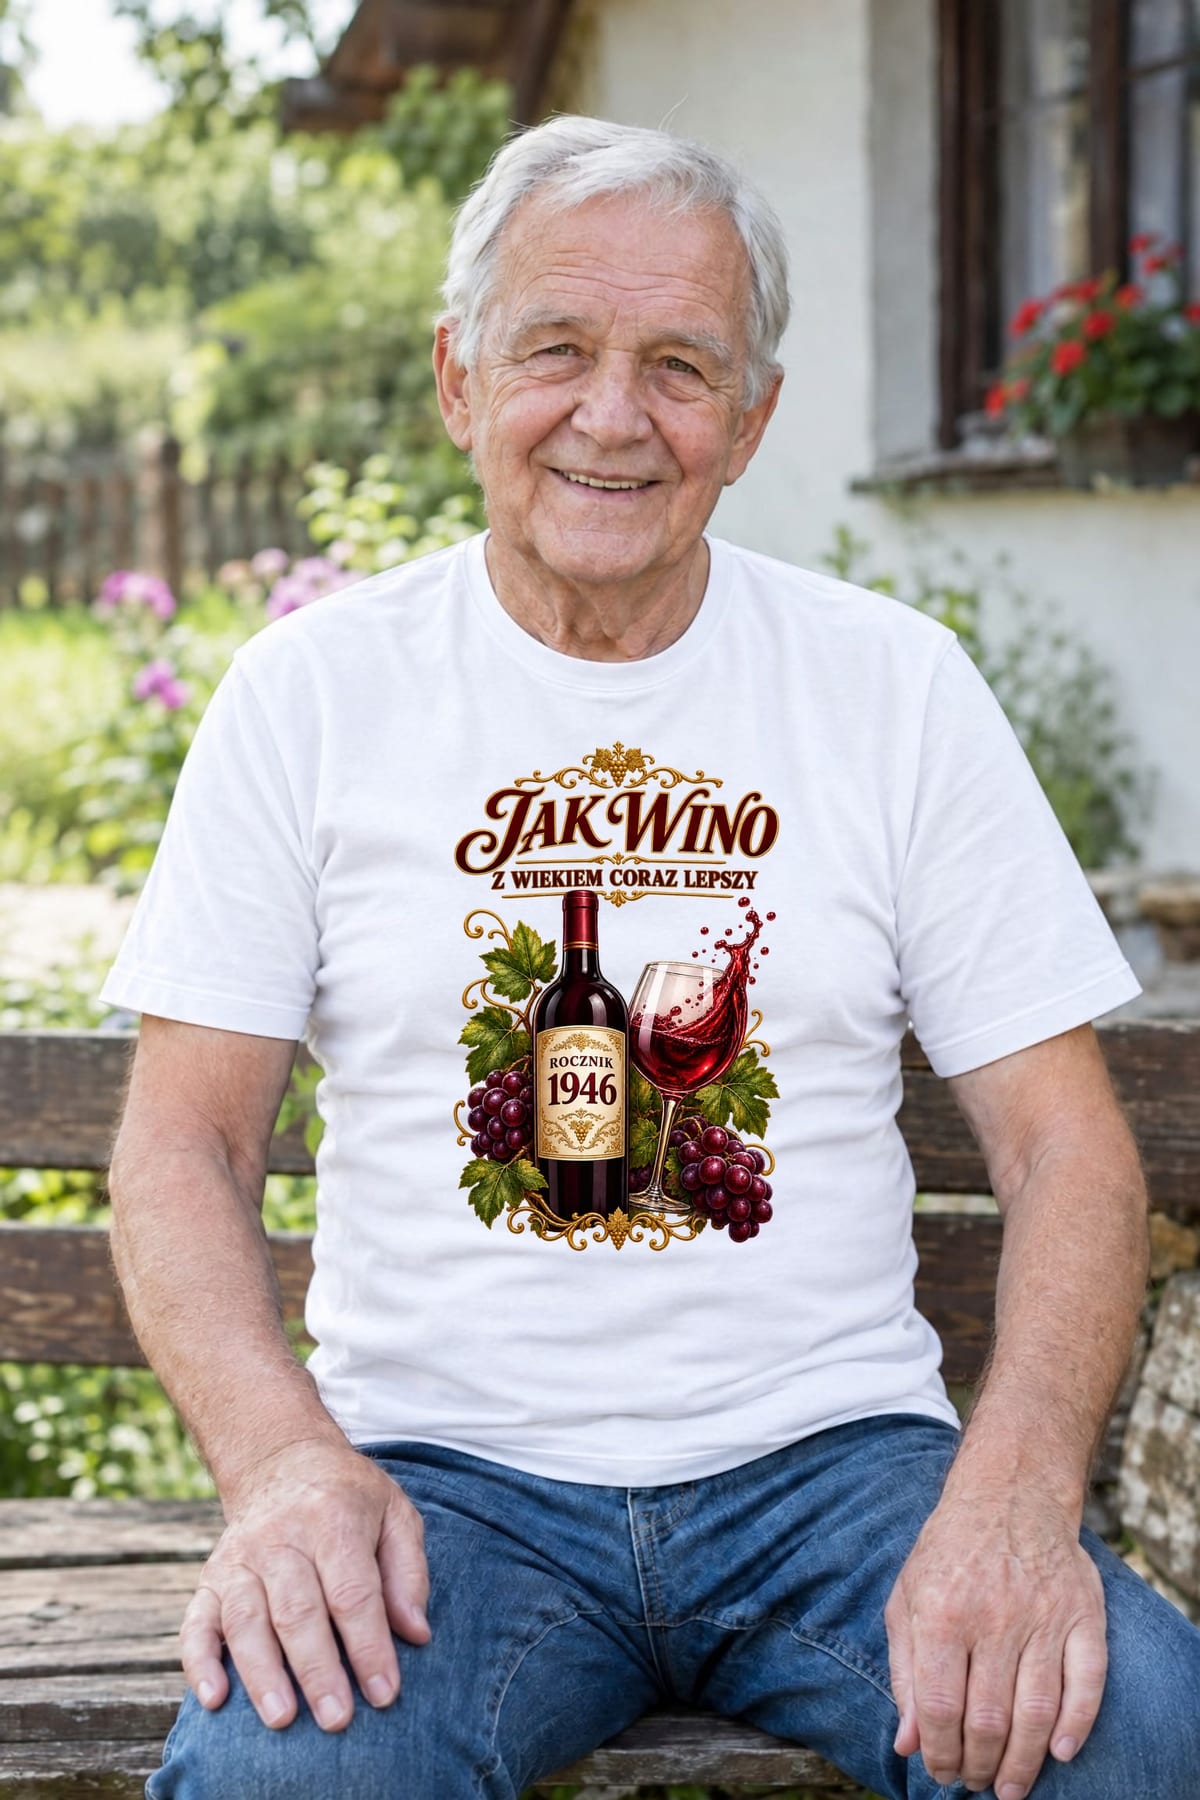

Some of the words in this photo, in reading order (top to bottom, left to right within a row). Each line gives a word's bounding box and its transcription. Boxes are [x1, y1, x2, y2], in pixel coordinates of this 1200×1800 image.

[454, 786, 612, 875] JAK
[606, 787, 779, 858] WINO
[491, 870, 506, 890] Z
[511, 869, 603, 889] WIEKIEM
[609, 868, 678, 889] CORAZ
[683, 869, 759, 890] LEPSZY
[549, 1055, 614, 1069] ROCZNIK
[547, 1071, 617, 1106] 1946
